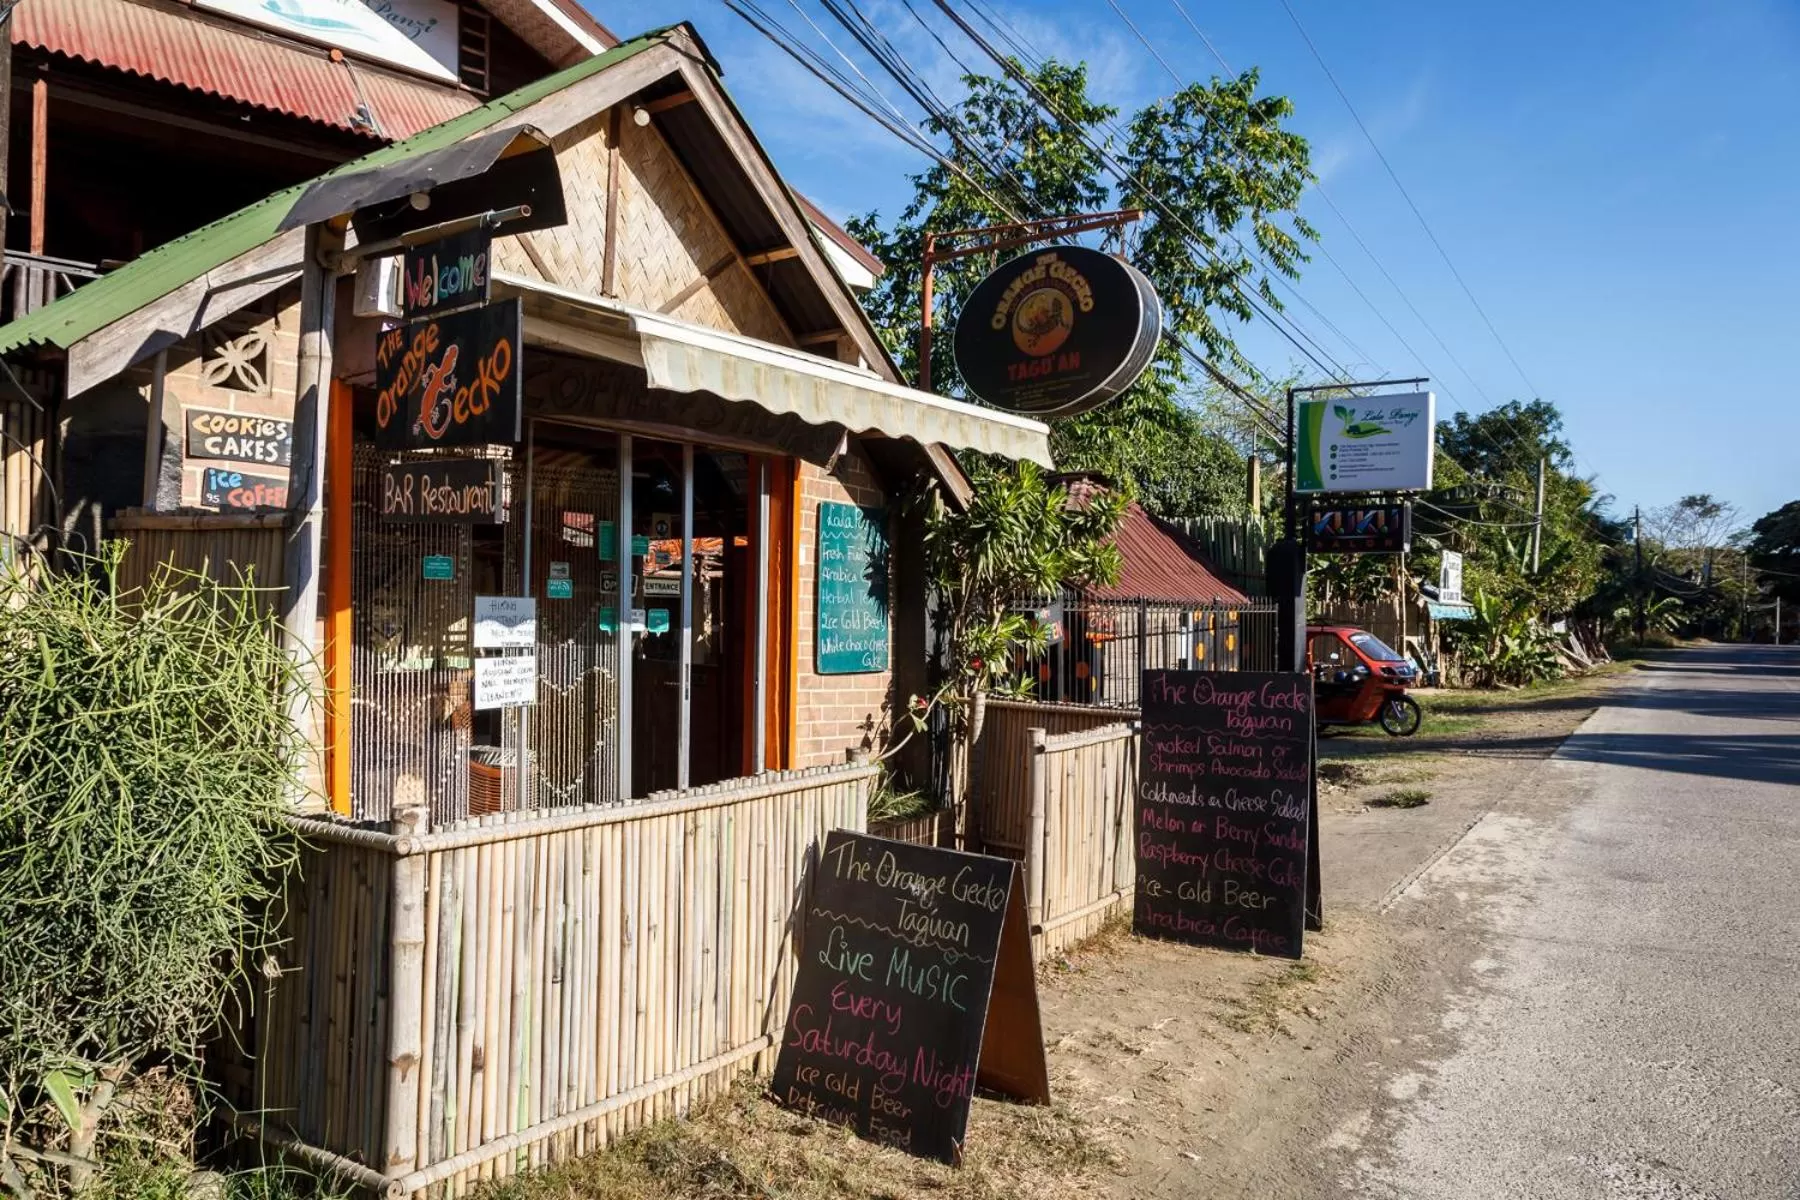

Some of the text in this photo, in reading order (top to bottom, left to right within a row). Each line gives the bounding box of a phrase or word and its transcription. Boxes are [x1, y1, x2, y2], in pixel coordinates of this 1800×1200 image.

[406, 253, 486, 310] Welcome
[991, 264, 1047, 330] ORANGE
[378, 329, 403, 369] THE
[377, 323, 440, 428] Orange
[205, 437, 278, 462] CAKES
[206, 493, 220, 503] 95
[209, 469, 242, 490] ice
[384, 464, 495, 516] BAR Restaurant
[645, 581, 679, 591] ENTRANCE
[1152, 672, 1187, 705] The
[1193, 676, 1256, 717] Orange
[1224, 708, 1292, 737] Taguan
[1145, 731, 1200, 755] Smoked
[1207, 735, 1263, 758] Salmon
[1149, 753, 1205, 779] Shrimps
[1211, 757, 1271, 779] Avocado
[1224, 787, 1268, 812] Cheese
[1271, 788, 1307, 822] Salad
[1142, 807, 1186, 834] Melon
[1215, 815, 1260, 857] Berry
[828, 840, 1005, 912] The Orange Gecko
[1139, 832, 1210, 878] Raspberry
[1214, 848, 1267, 878] Cheese
[1224, 879, 1277, 910] Beer
[896, 898, 970, 947] Taguan
[819, 925, 873, 981] Live
[831, 980, 903, 1034] Every
[788, 1004, 974, 1109] Saturday Night
[870, 1083, 912, 1119] Beer
[870, 1116, 912, 1147] Food
